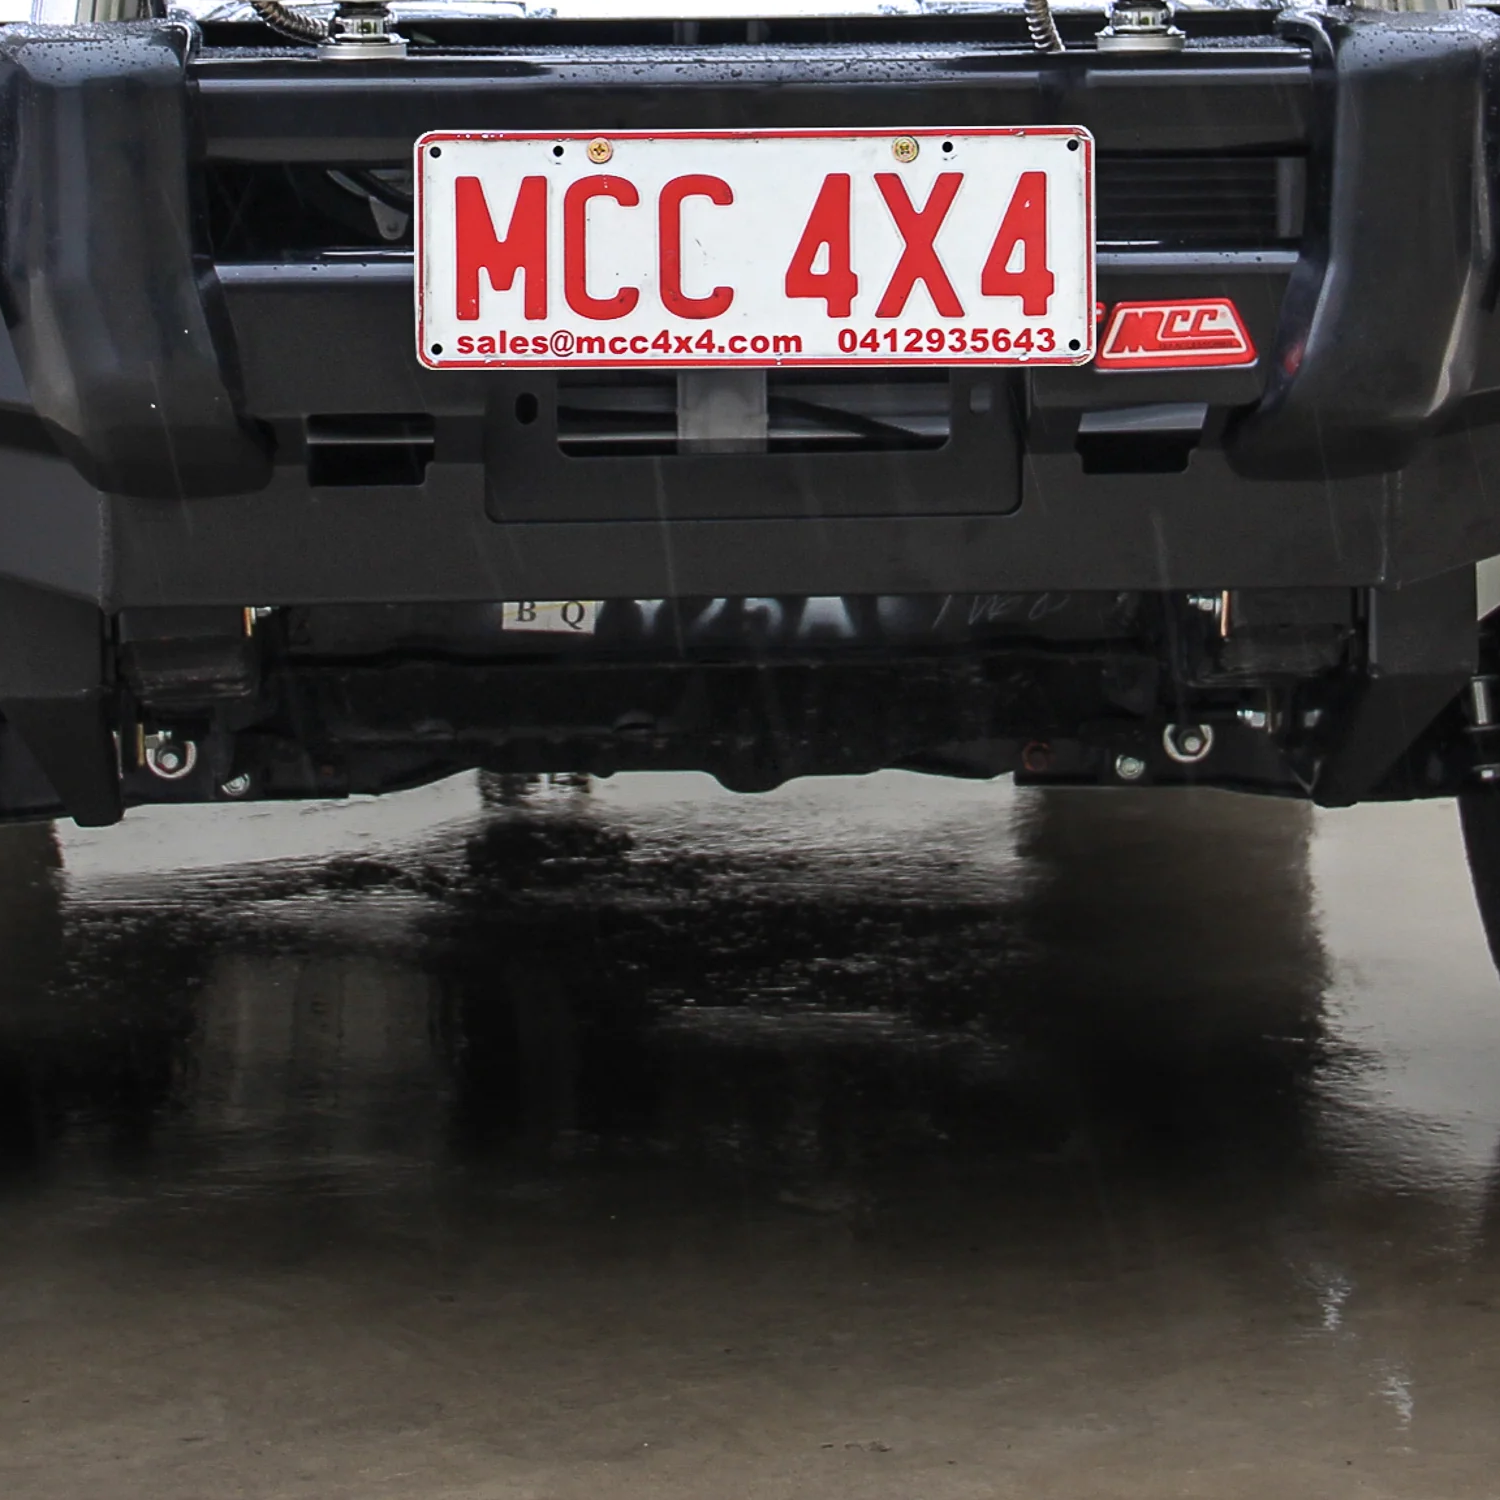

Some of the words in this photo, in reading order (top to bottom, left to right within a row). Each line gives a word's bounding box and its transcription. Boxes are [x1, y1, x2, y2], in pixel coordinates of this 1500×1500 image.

[455, 173, 735, 322] MCC
[784, 170, 1055, 320] 4X4
[455, 327, 803, 358] sales@mcc4x4.com
[837, 327, 1056, 354] 0412935643
[1106, 308, 1236, 353] MCC
[515, 599, 538, 623] B
[560, 600, 586, 630] Q
